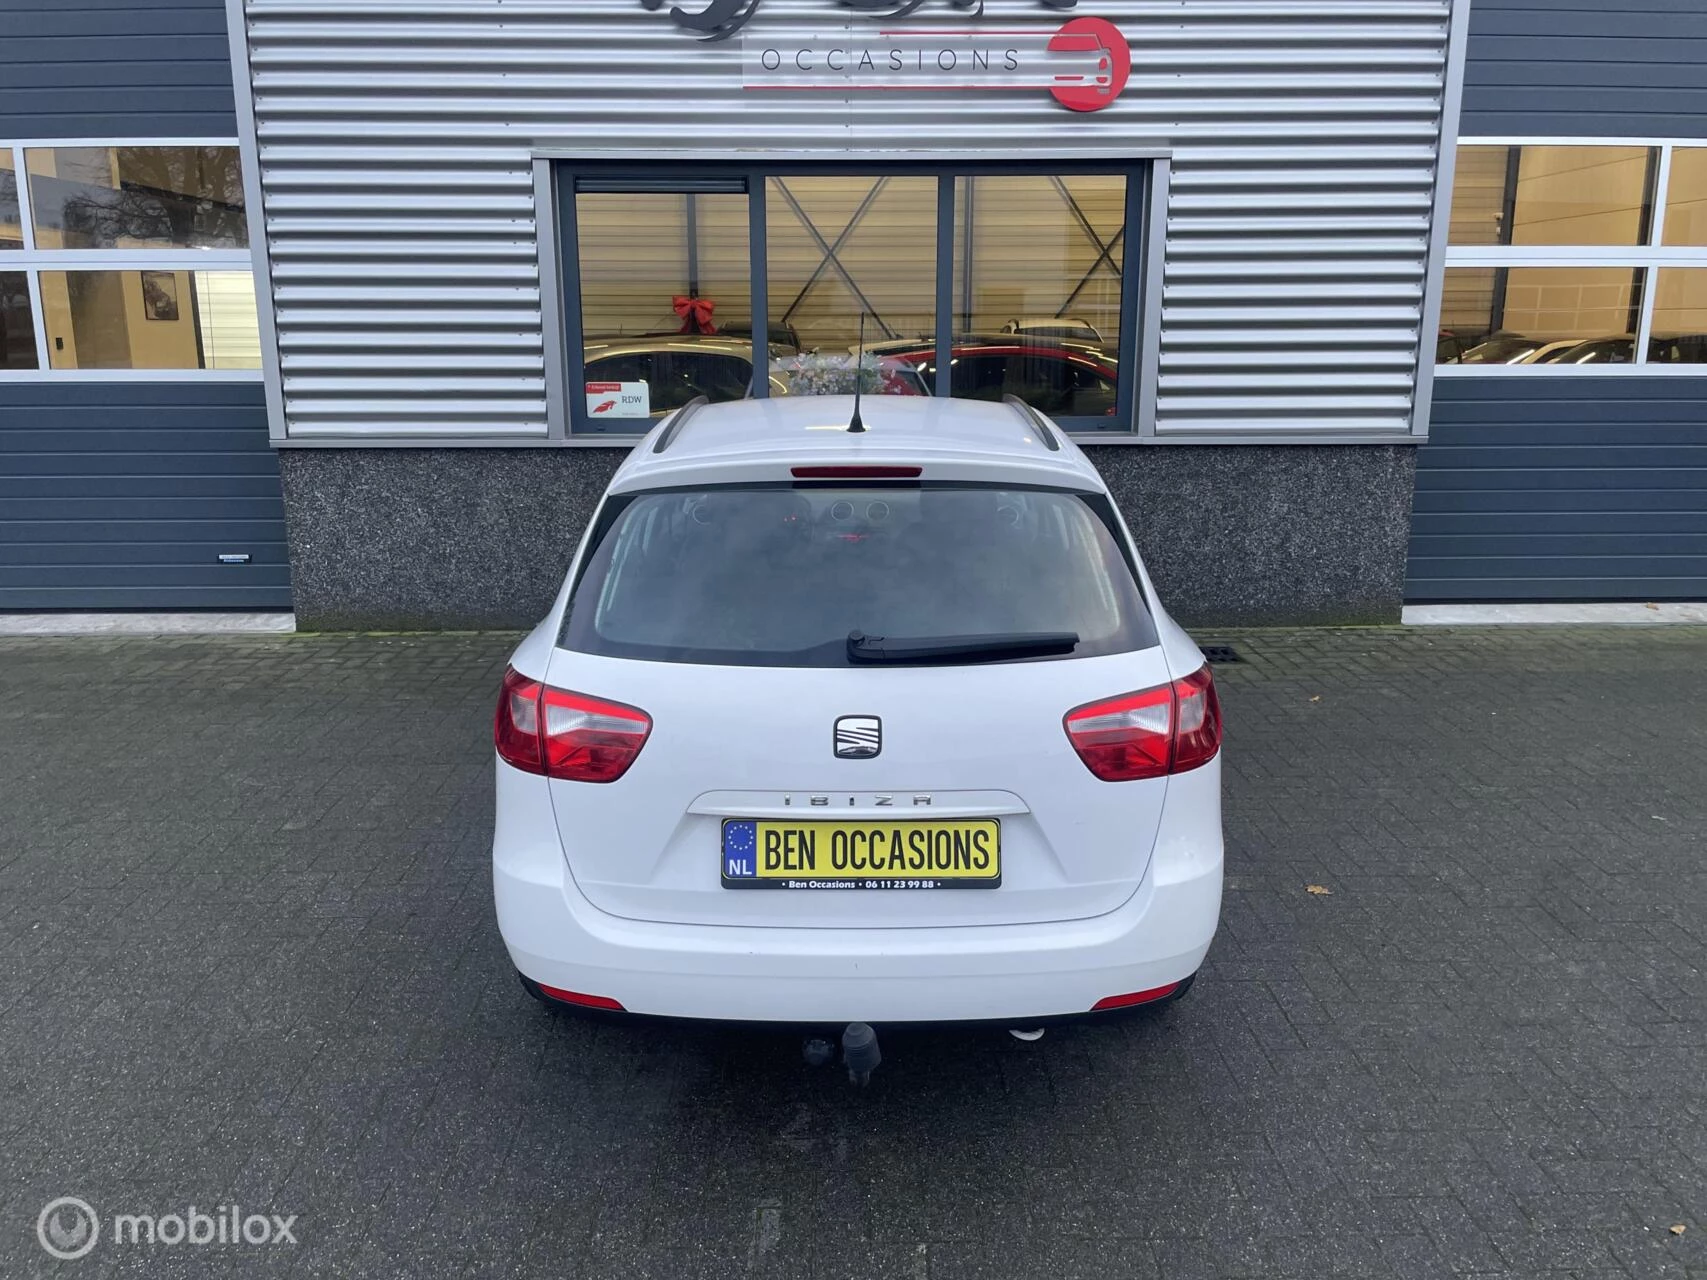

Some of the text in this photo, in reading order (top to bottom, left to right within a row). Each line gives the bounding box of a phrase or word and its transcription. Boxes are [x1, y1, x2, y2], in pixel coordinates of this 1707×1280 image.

[761, 48, 1020, 71] OCCASIONS
[621, 395, 642, 404] RDW
[784, 794, 932, 806] IBIZA
[764, 829, 990, 871] BEN OCCASIONS
[728, 859, 753, 875] NL
[788, 880, 934, 889] Ben Occasions 06 11 23 99 88
